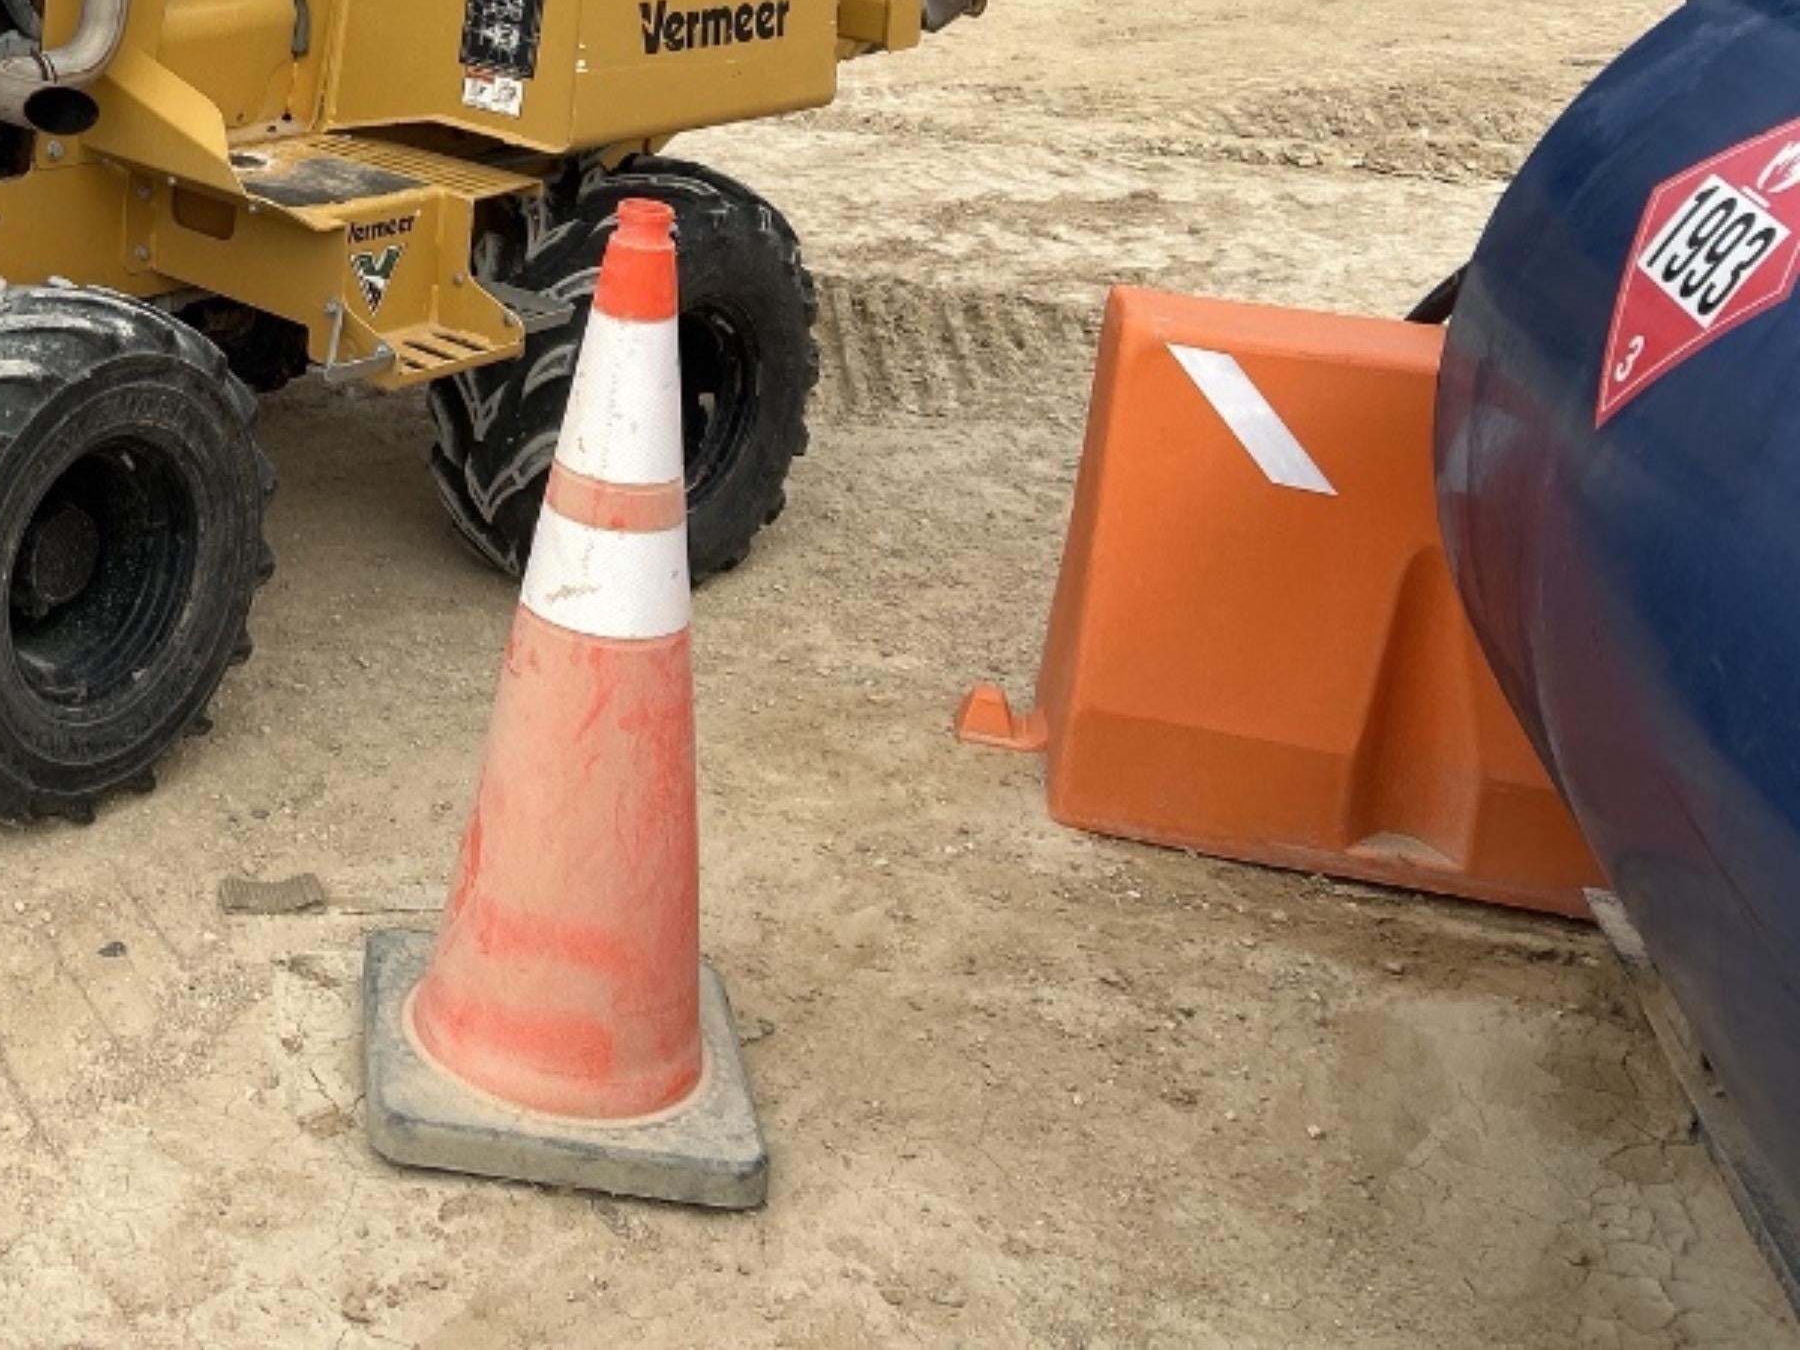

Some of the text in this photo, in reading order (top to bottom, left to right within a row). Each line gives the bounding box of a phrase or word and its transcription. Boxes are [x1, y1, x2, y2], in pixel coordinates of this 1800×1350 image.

[638, 0, 791, 55] Vermeer
[1646, 185, 1777, 316] 1993
[1615, 335, 1645, 382] 3
